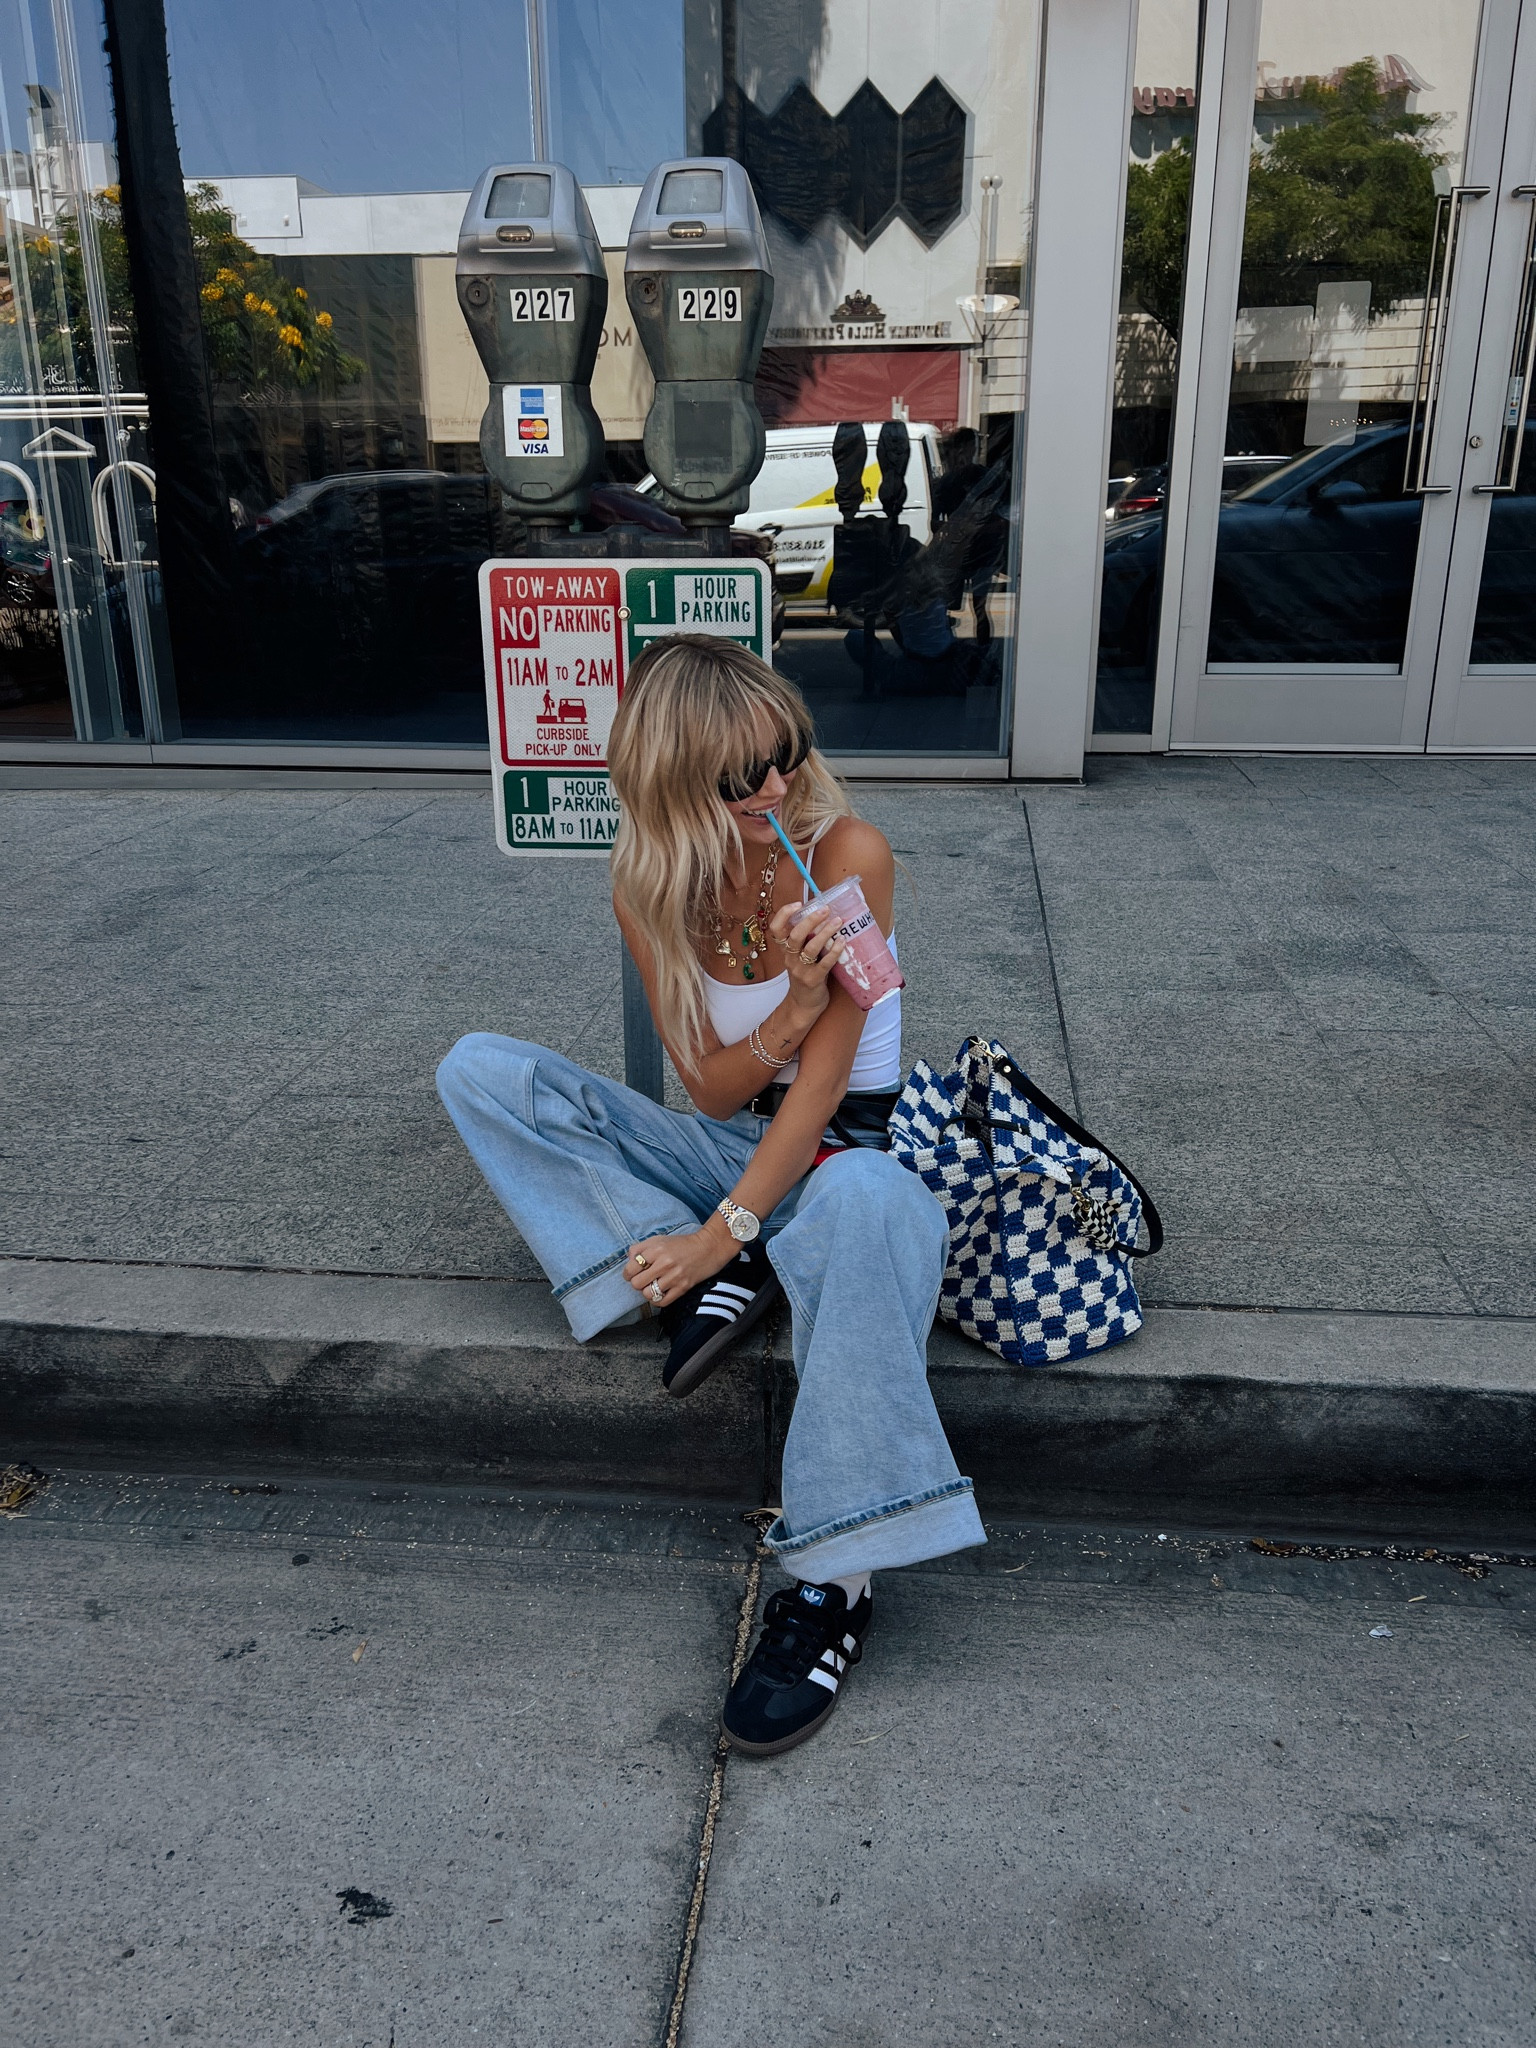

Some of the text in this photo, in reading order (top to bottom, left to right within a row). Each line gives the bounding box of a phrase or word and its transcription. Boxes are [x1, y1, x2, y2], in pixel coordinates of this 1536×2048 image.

[515, 290, 570, 319] 227
[683, 289, 737, 319] 229
[522, 443, 549, 454] VISA
[503, 576, 608, 599] TOW-AWAY
[647, 577, 737, 619] 1 HOUR
[499, 606, 611, 641] NO PARKING
[681, 601, 751, 623] PARKING
[506, 657, 614, 687] 11AM TO 2AM
[536, 728, 590, 741] CURBSIDE
[525, 743, 602, 756] PICK-UP ONLY
[520, 776, 608, 808] 1 HOUR
[552, 796, 621, 813] PARKING
[515, 815, 620, 840] 8AM TO 11AM
[831, 910, 875, 941] EREWH
